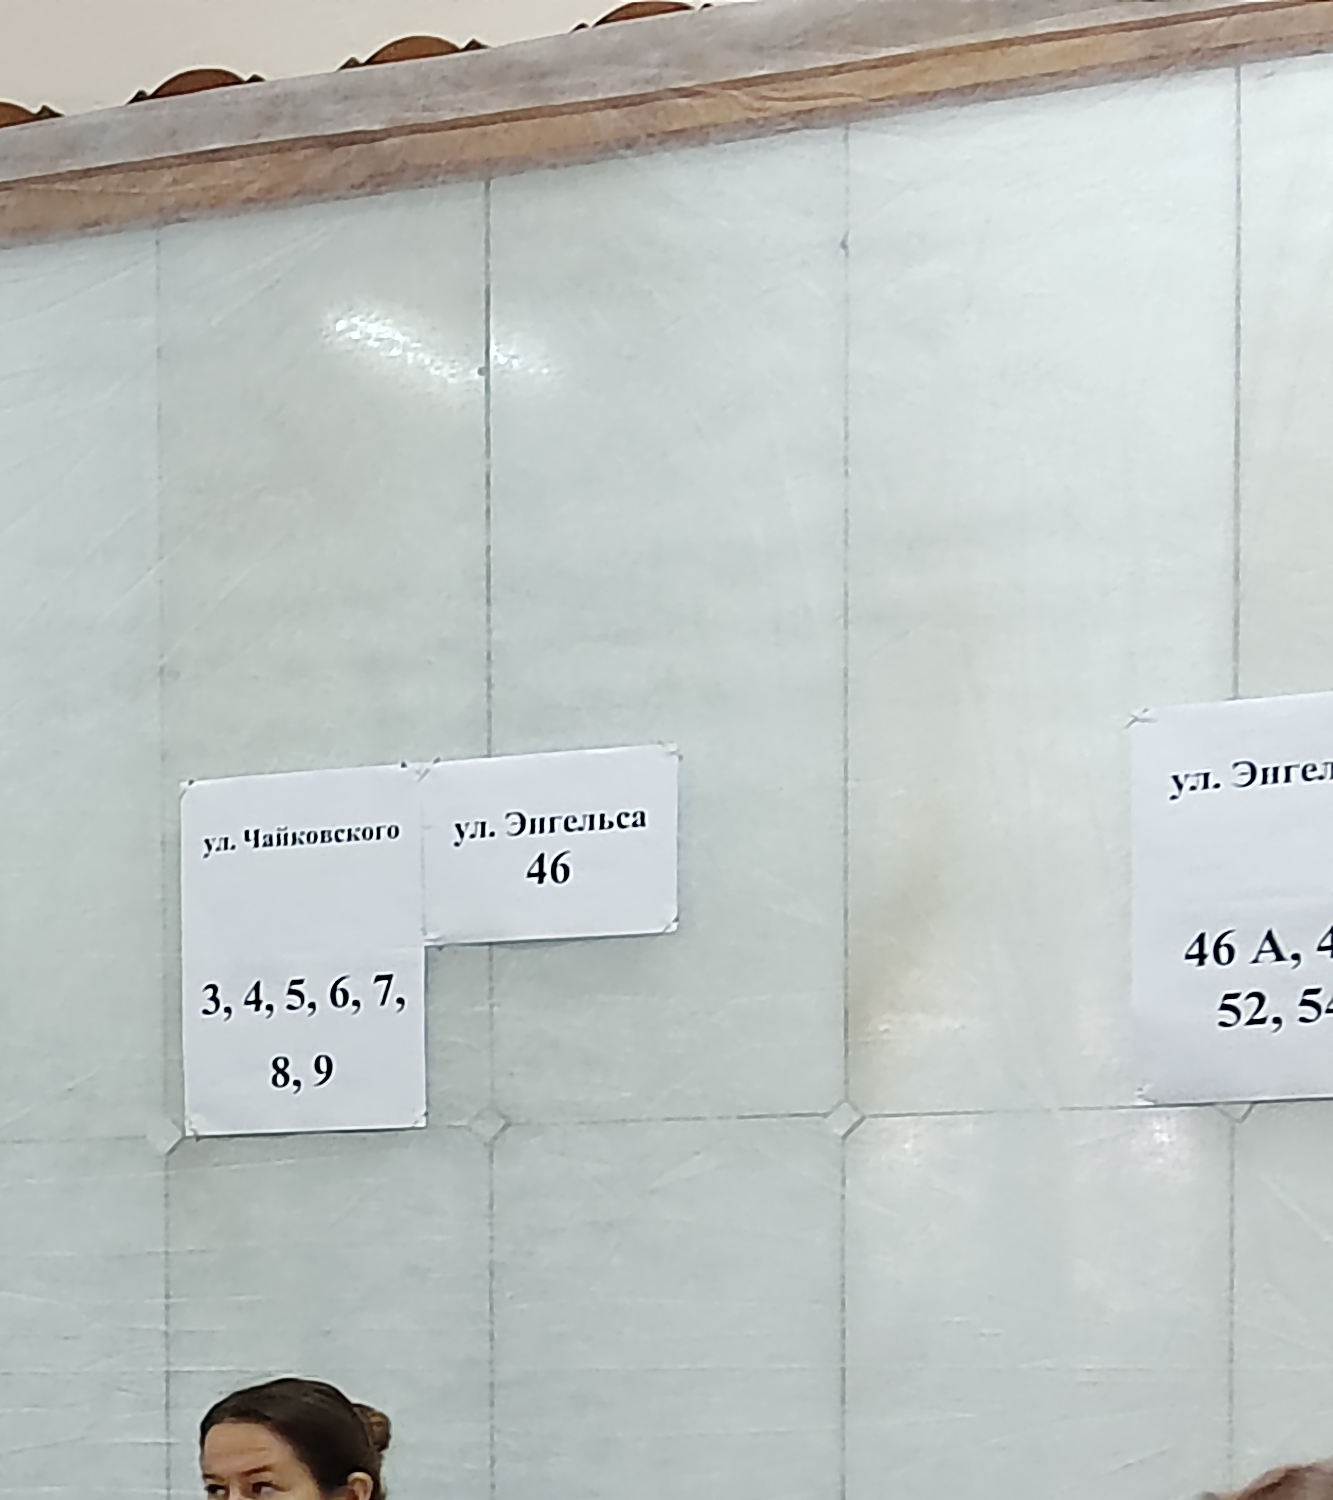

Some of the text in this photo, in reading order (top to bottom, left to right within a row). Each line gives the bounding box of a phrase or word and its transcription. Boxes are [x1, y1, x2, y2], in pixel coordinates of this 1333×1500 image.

[1169, 771, 1222, 801] ул.
[202, 825, 400, 859] ул. Чайковского
[453, 810, 647, 848] ул. Энгельса
[525, 850, 571, 885] 46
[1184, 929, 1236, 967] 46
[201, 973, 406, 1023] 3, 4, 5, 6, 7,
[1217, 990, 1283, 1034] 52,
[271, 1054, 334, 1096] 8, 9
